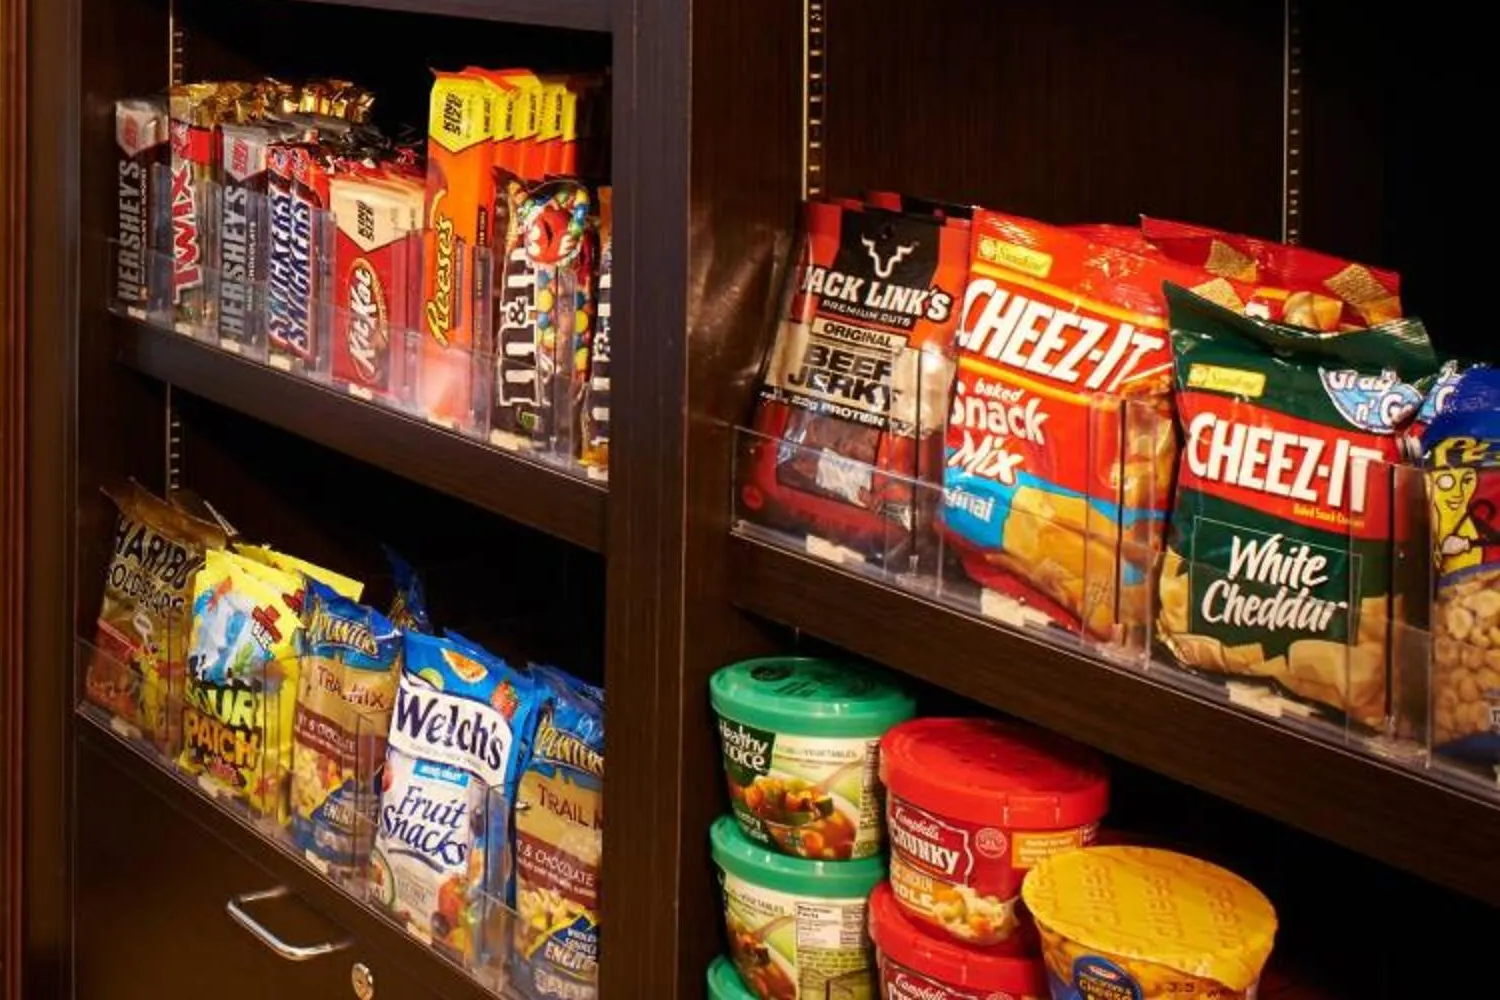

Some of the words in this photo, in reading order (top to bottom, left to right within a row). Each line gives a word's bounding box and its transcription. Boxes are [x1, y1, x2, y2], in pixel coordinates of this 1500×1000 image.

[117, 159, 141, 301] HERSHEY'S
[171, 160, 203, 305] TWIX
[220, 184, 249, 336] HERSHEY'S
[425, 214, 455, 347] Reese's
[821, 298, 878, 321] PREMIUM
[865, 281, 952, 322] LINK'S
[823, 322, 893, 347] ORIGINAL
[956, 278, 1165, 393] CHEEZ-IT
[803, 344, 893, 382] BEEF
[974, 377, 1026, 403] baked
[821, 402, 886, 427] PROTEIN
[947, 430, 1025, 486] Mix
[1187, 411, 1384, 513] CHEEZ-IT
[1228, 532, 1329, 589] White
[1201, 579, 1349, 635] Cheddar
[396, 692, 504, 778] Welch's
[397, 784, 469, 830] Fruit
[537, 783, 589, 828] TRAIL
[381, 804, 468, 867] Snacks
[535, 849, 595, 887] CHOCOLATE
